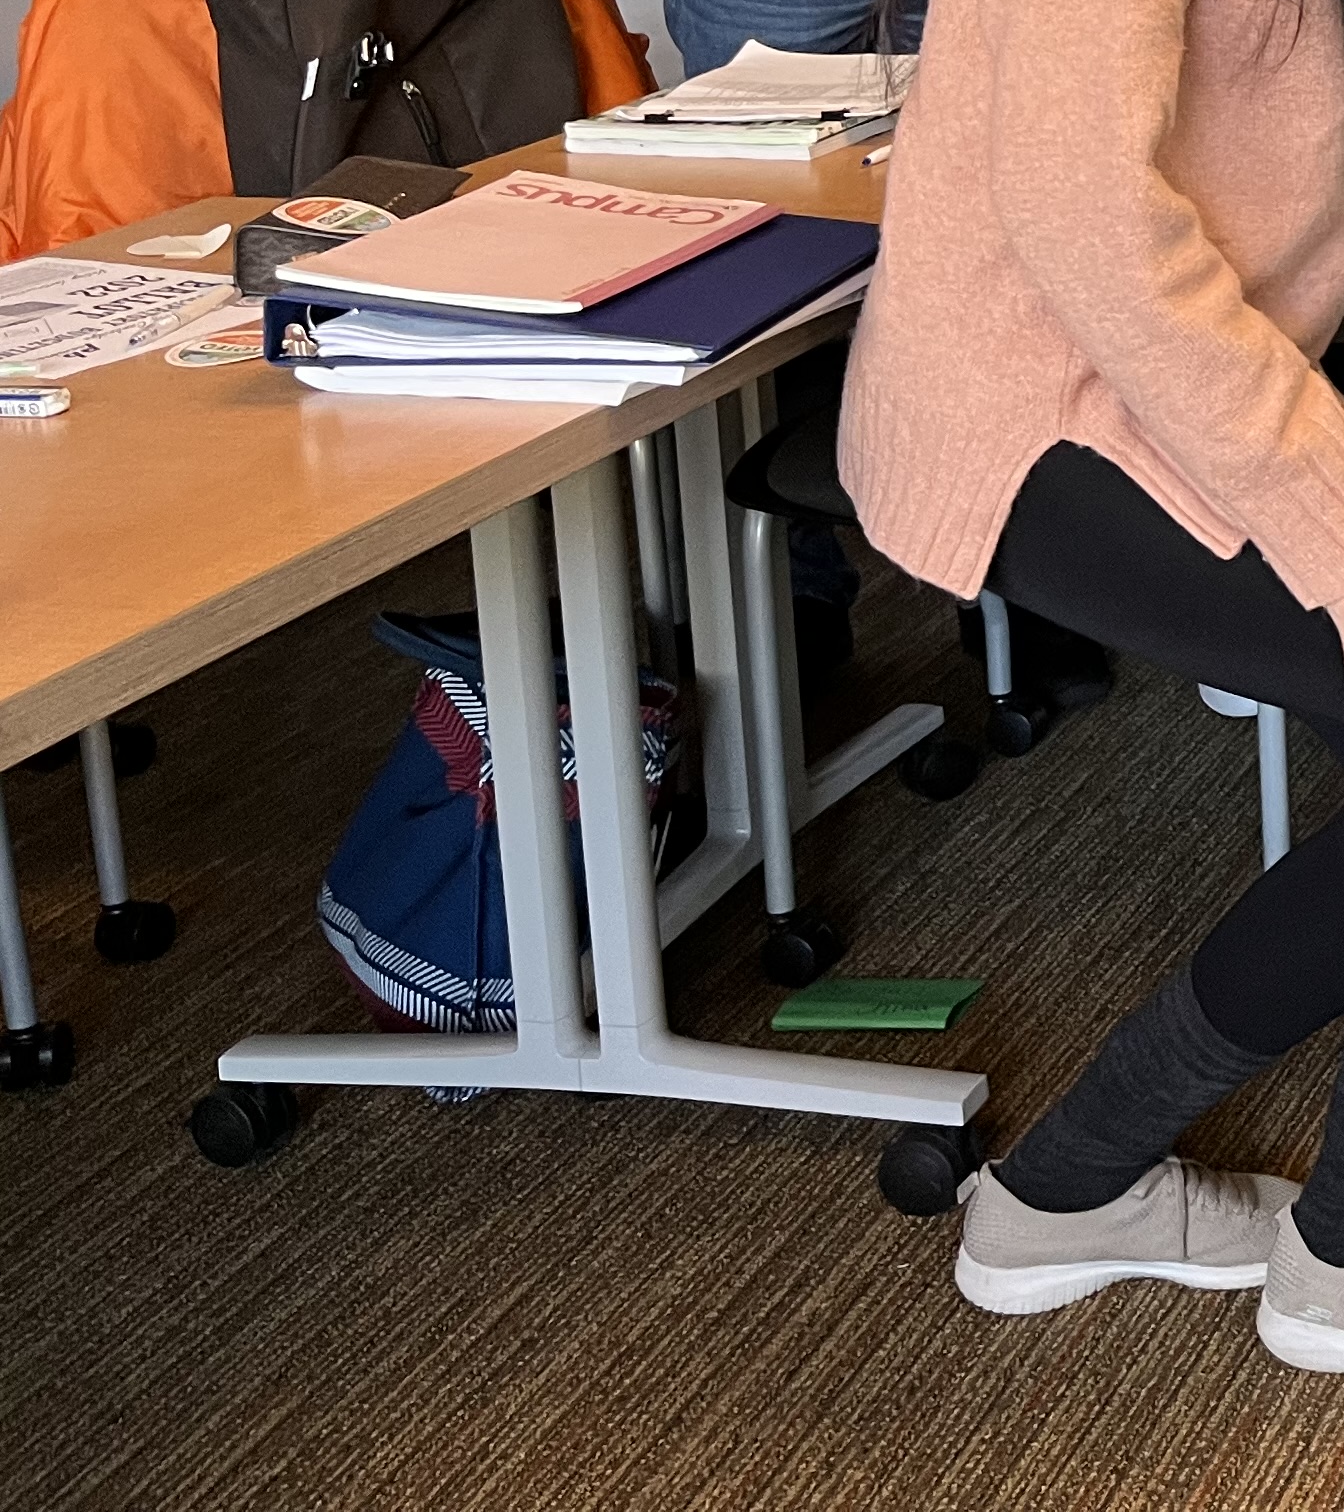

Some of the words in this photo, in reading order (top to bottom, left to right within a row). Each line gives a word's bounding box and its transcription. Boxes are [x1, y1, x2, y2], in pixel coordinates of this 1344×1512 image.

[496, 182, 725, 225] Campus
[66, 274, 165, 298] 2022
[68, 279, 223, 319] BALLOT
